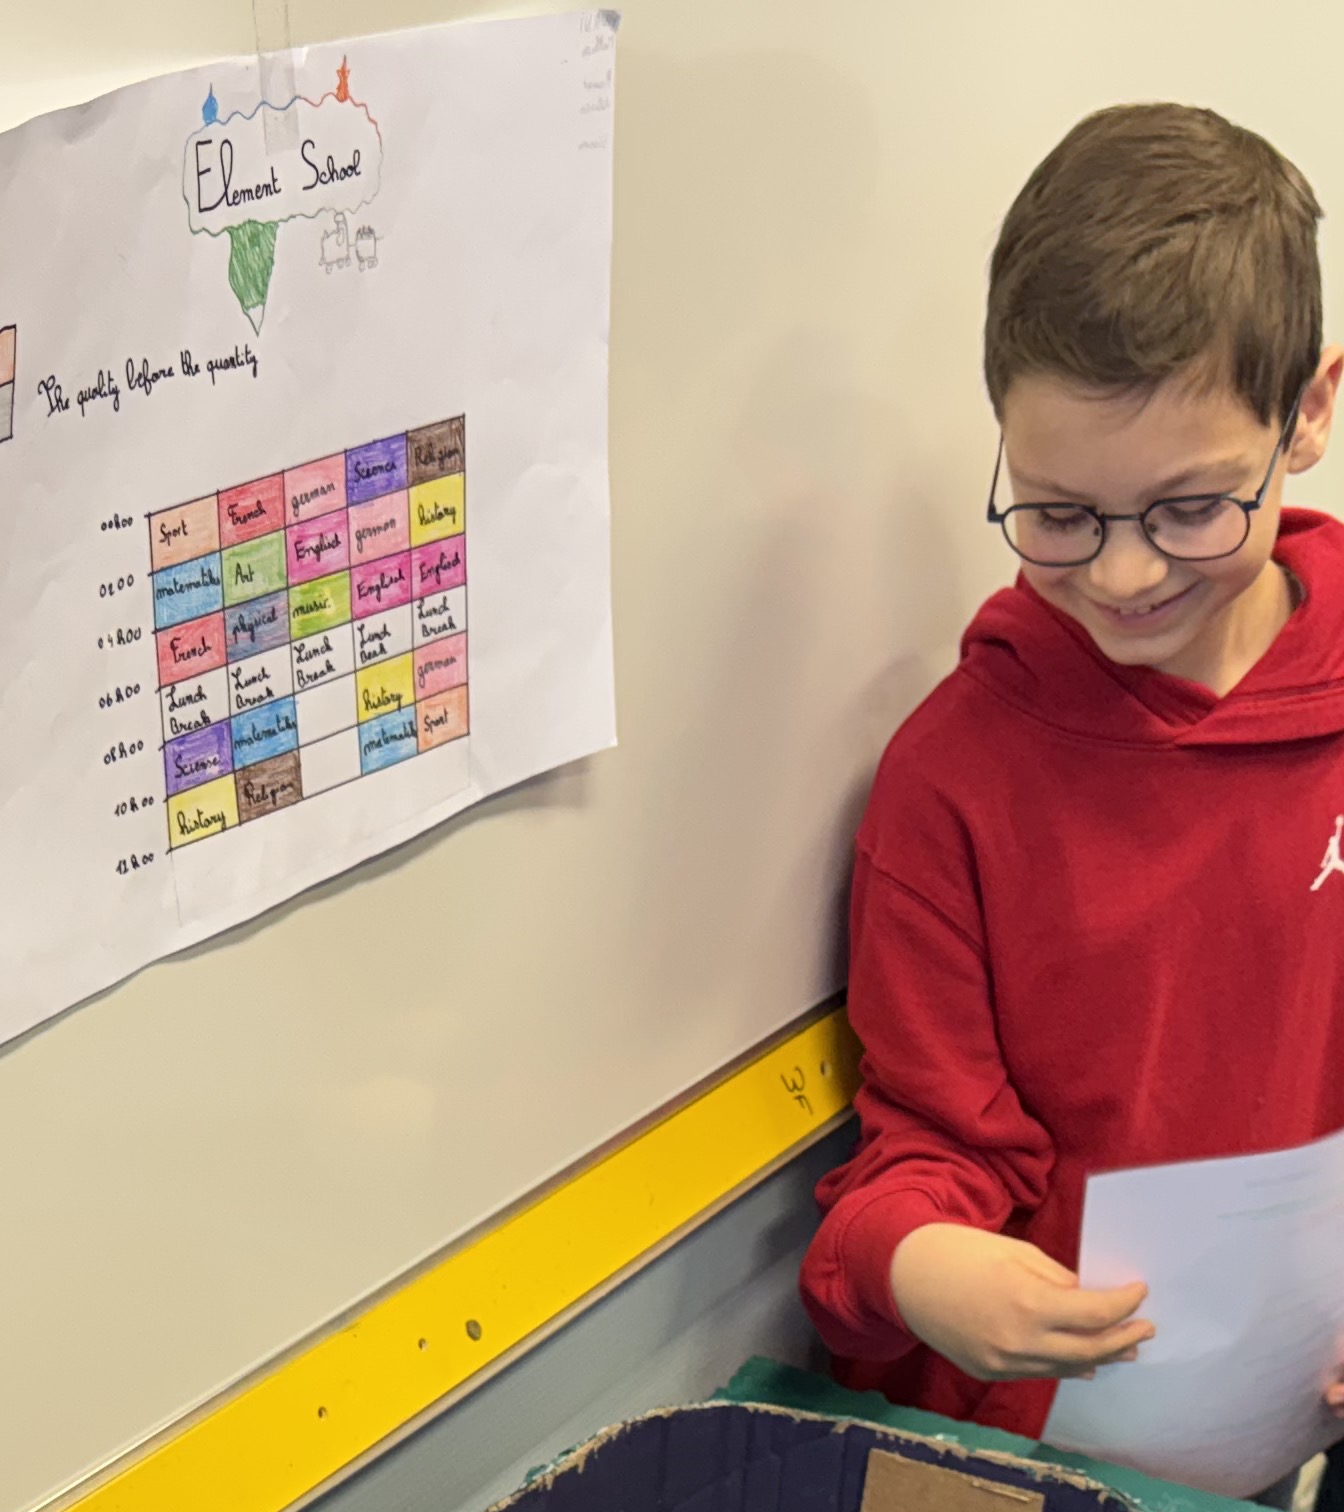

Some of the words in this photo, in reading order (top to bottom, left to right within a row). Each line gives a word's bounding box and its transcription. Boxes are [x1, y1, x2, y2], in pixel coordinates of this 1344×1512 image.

[195, 138, 282, 213] Element
[300, 138, 362, 191] School
[38, 375, 70, 417] The
[76, 369, 120, 417] quality
[126, 357, 174, 396] before
[180, 349, 201, 377] the
[206, 344, 258, 386] quantity
[417, 501, 456, 527] history
[159, 520, 188, 546] Sport
[234, 562, 254, 585] Art
[170, 636, 212, 663] French
[293, 636, 334, 664] Lunch
[231, 666, 271, 690] Lunch
[166, 685, 207, 712] Lunch
[362, 686, 403, 711] history
[176, 808, 227, 836] history
